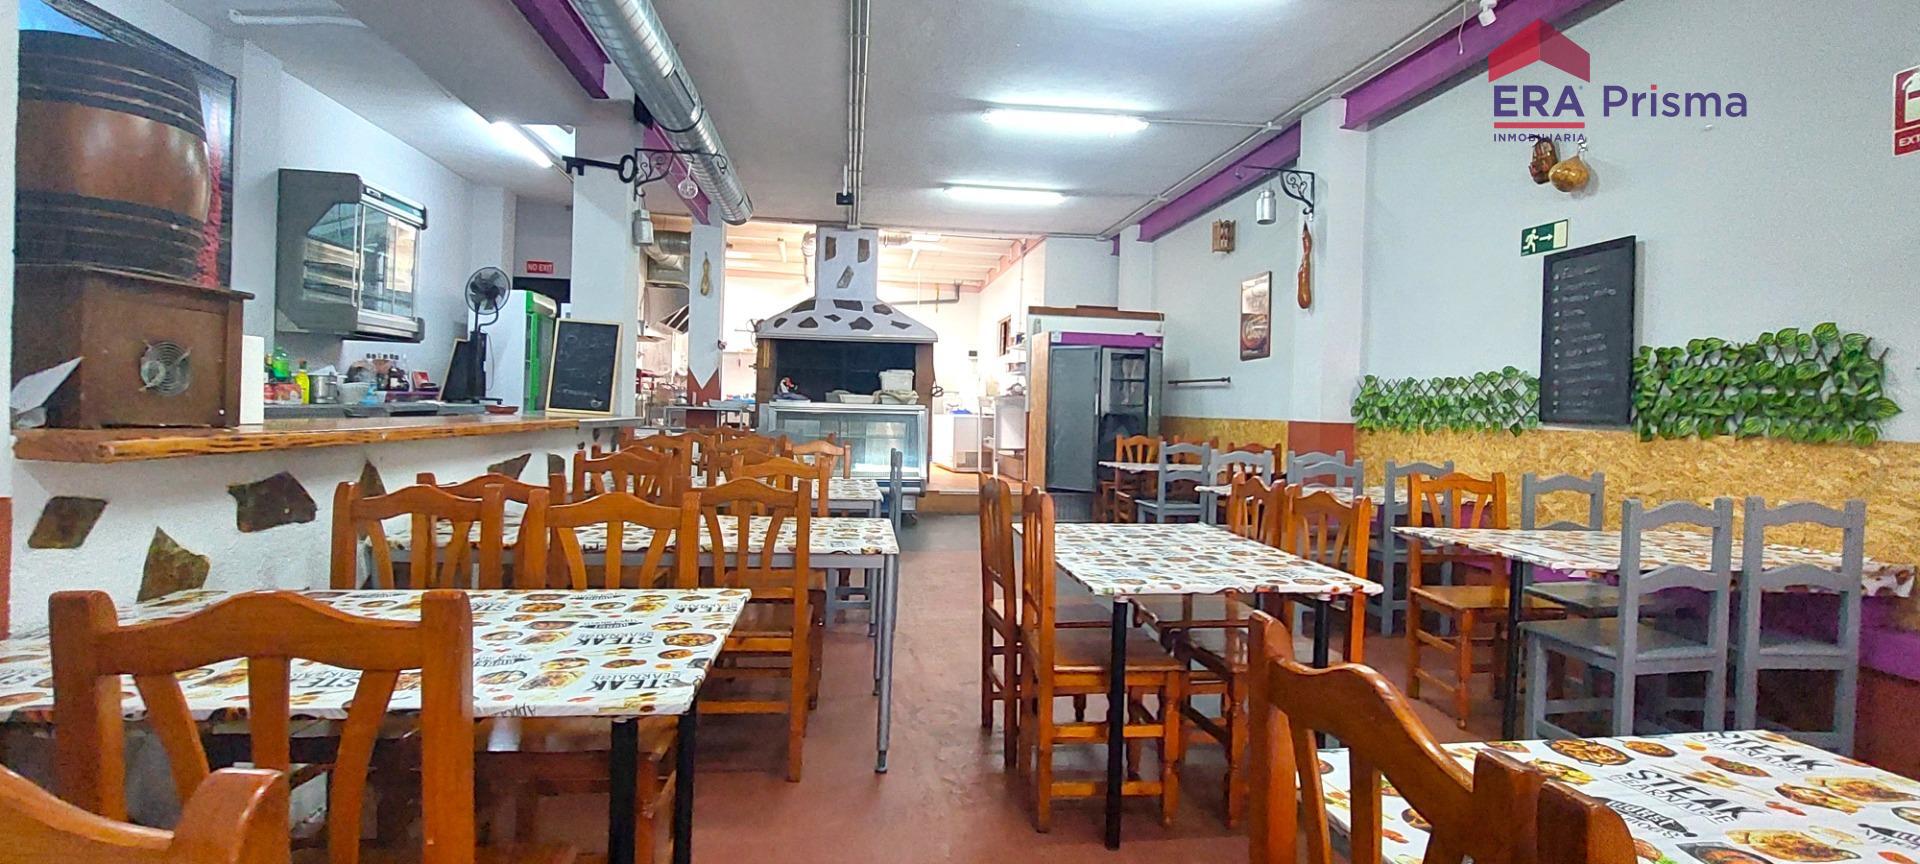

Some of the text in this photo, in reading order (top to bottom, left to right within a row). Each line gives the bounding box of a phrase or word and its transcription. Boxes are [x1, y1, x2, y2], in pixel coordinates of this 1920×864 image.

[527, 263, 553, 272] NO EXIT
[573, 635, 652, 646] STEAK
[585, 678, 681, 692] STEAK
[1626, 769, 1764, 819] STEAK
